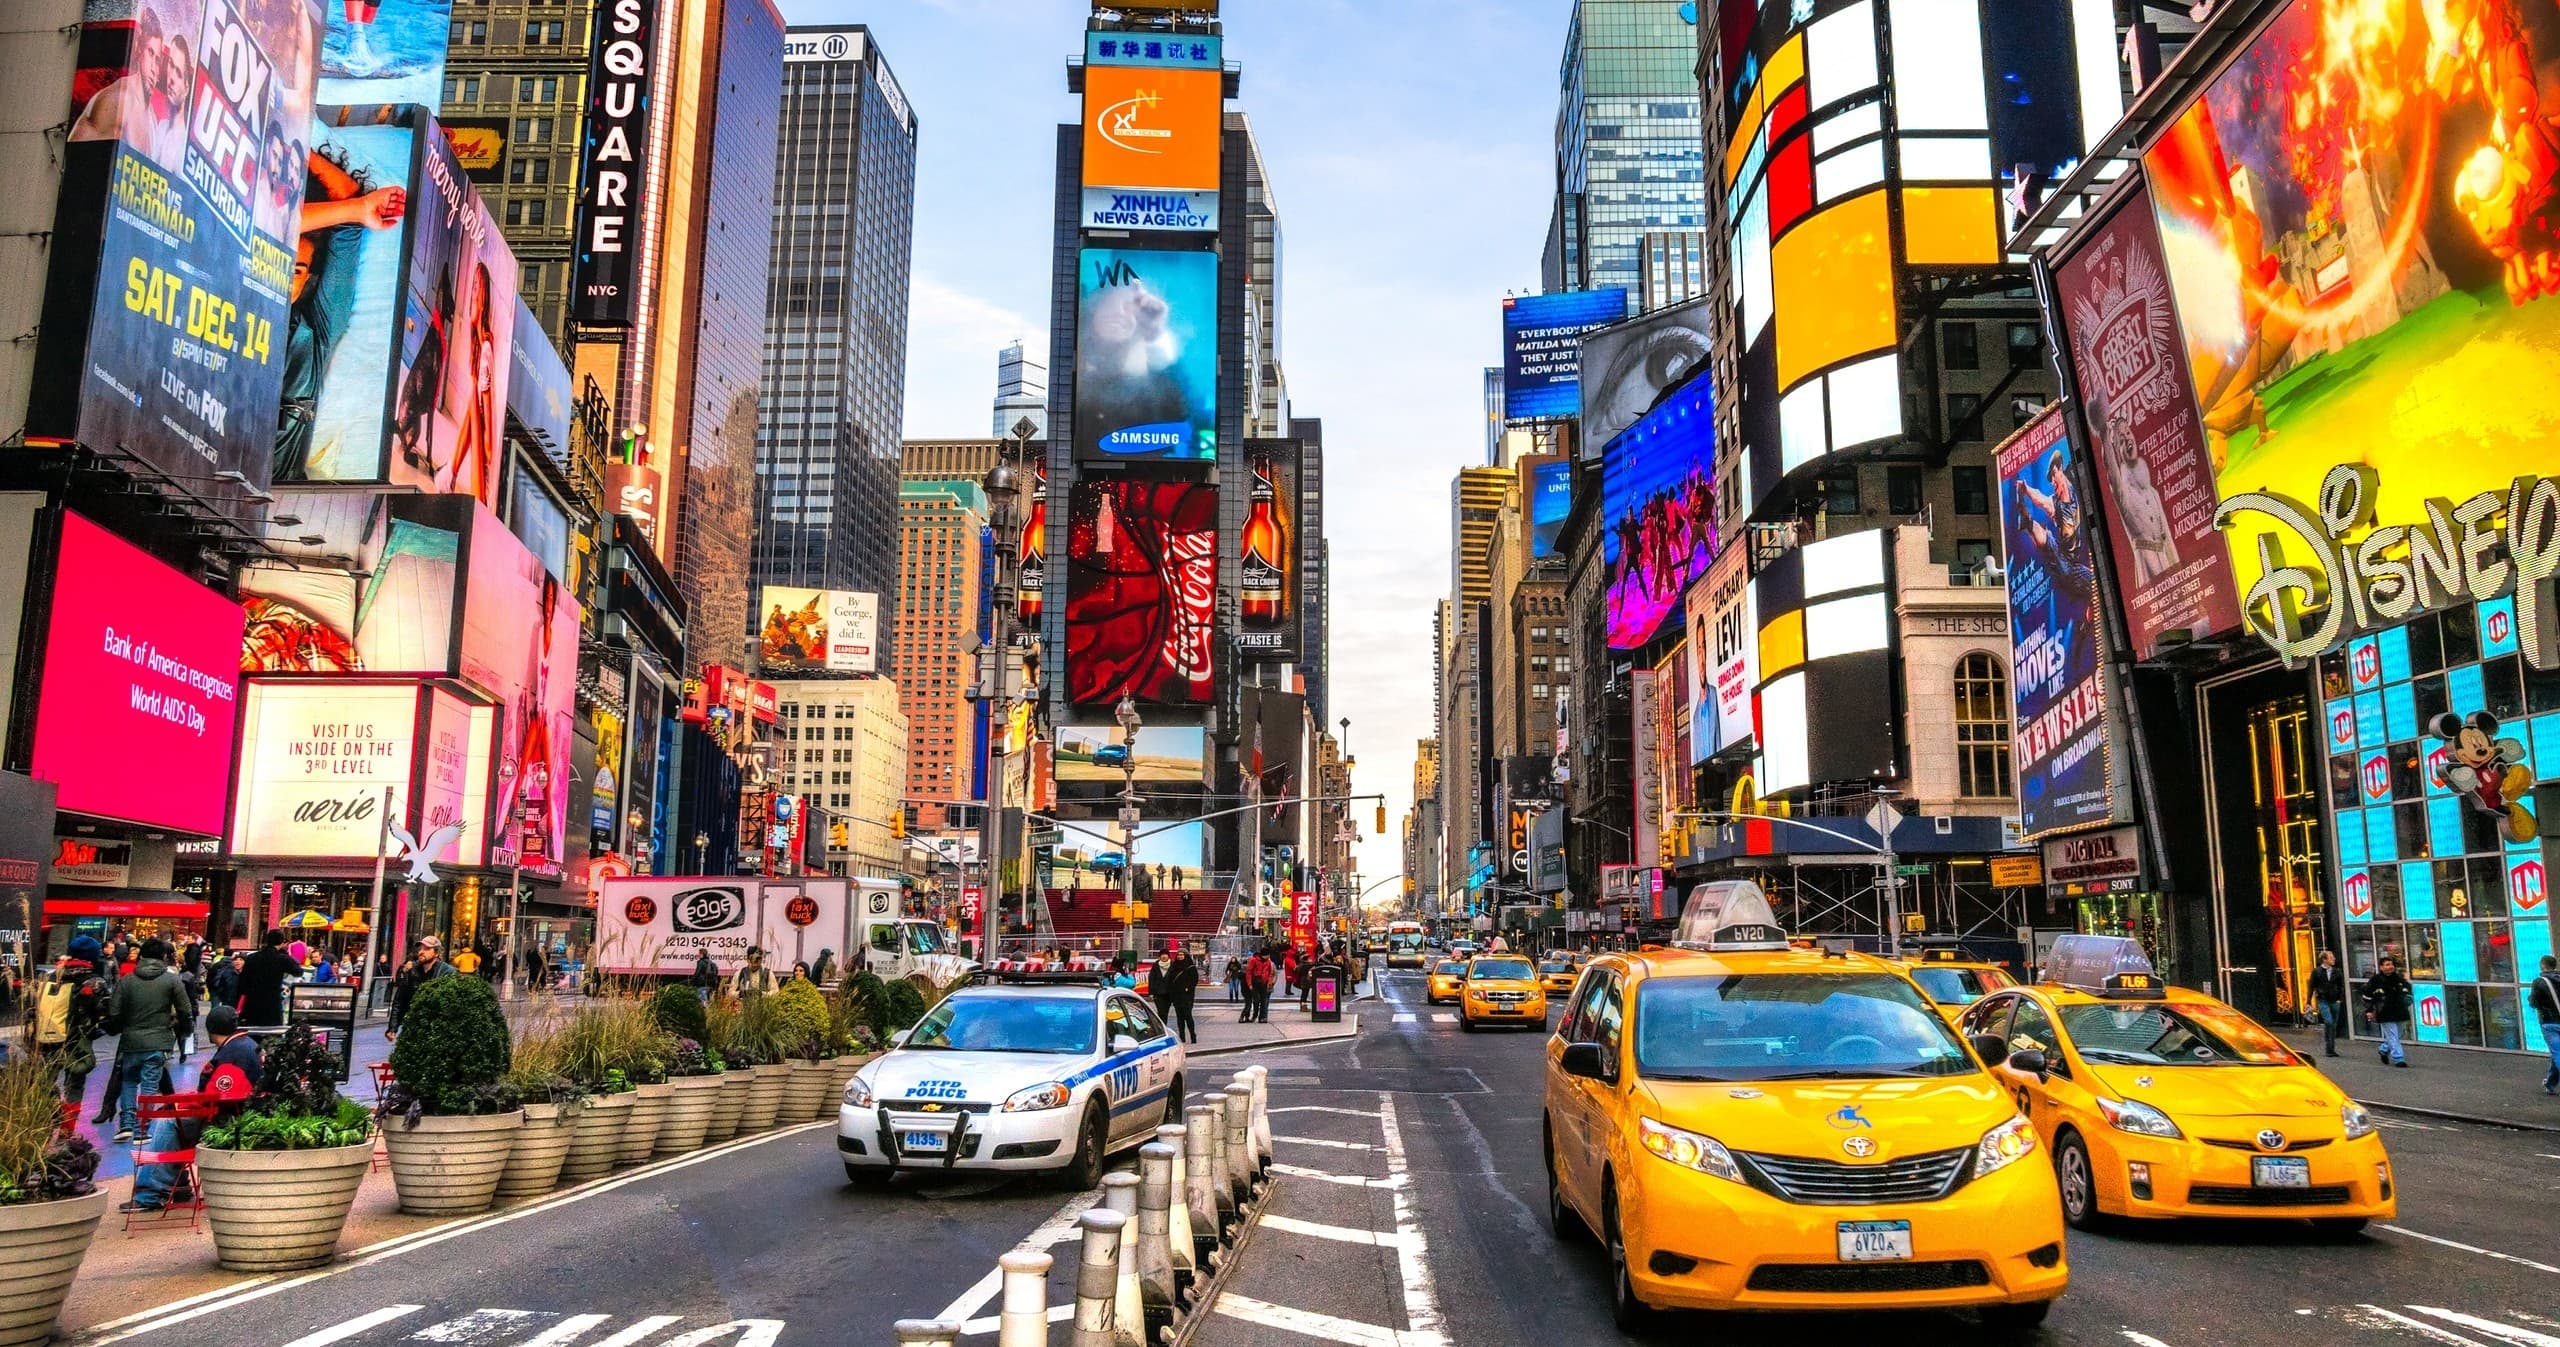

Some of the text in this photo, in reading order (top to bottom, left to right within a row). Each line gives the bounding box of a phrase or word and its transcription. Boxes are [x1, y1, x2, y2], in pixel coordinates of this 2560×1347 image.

[1099, 41, 1208, 61] 新华通讯社
[200, 8, 271, 140] FOX
[591, 0, 645, 253] SQUARE
[192, 97, 259, 197] UFC
[122, 155, 183, 211] FABER VS
[185, 145, 250, 237] SATURDAY
[426, 143, 461, 229] merry
[118, 179, 195, 244] McDONALD
[1112, 195, 1191, 214] XINHUA
[1094, 212, 1208, 228] NEWS AGENCY
[588, 285, 618, 297] NYC
[125, 256, 271, 366] SAT. DEC. 14
[172, 337, 203, 366] 8/5PM
[1515, 340, 1559, 352] MATILDA
[2102, 312, 2143, 371] GREAT
[1521, 351, 1574, 363] THEY JUST
[1520, 363, 1579, 376] KNOW HOW
[2105, 340, 2149, 397] COMET
[161, 367, 228, 437] LIVE ON FOX
[2158, 415, 2180, 442] TALK
[2178, 407, 2189, 427] OF
[1111, 432, 1180, 446] SAMSUNG
[2150, 446, 2168, 468] THE
[2157, 469, 2163, 485] A
[2172, 485, 2209, 519] ORIGINAL
[2180, 577, 2200, 596] STREET
[834, 607, 873, 620] George,
[848, 597, 860, 609] By
[838, 628, 855, 639] did
[846, 620, 860, 628] we
[1716, 602, 1742, 667] LEVI
[1935, 617, 1966, 632] THE
[1273, 635, 1283, 646] IS
[2015, 622, 2047, 667] NOTHING
[104, 626, 235, 702] Bank of America recognizes
[2016, 629, 2066, 704] MOVES
[2048, 669, 2065, 700] LIKE
[131, 683, 206, 738] World AIDS Day.
[312, 723, 375, 738] VISIT US
[289, 742, 394, 756] INSIDE ON THE
[1641, 683, 1658, 825] PALACE
[305, 759, 374, 774] 3RD LEVEL
[2052, 755, 2064, 779] ON
[293, 789, 375, 823] aerie
[2280, 853, 2321, 866] MAC
[2111, 879, 2134, 891] SONY
[687, 898, 732, 921] edge
[964, 891, 978, 921] tkts
[1297, 895, 1312, 926] tkts
[666, 936, 748, 948] (212) 947-3343
[2120, 976, 2148, 988] 7L66
[905, 1087, 968, 1098] POLICE
[918, 1080, 962, 1088] NYPD
[1113, 1065, 1139, 1101] NYPD
[906, 1132, 937, 1146] 4135
